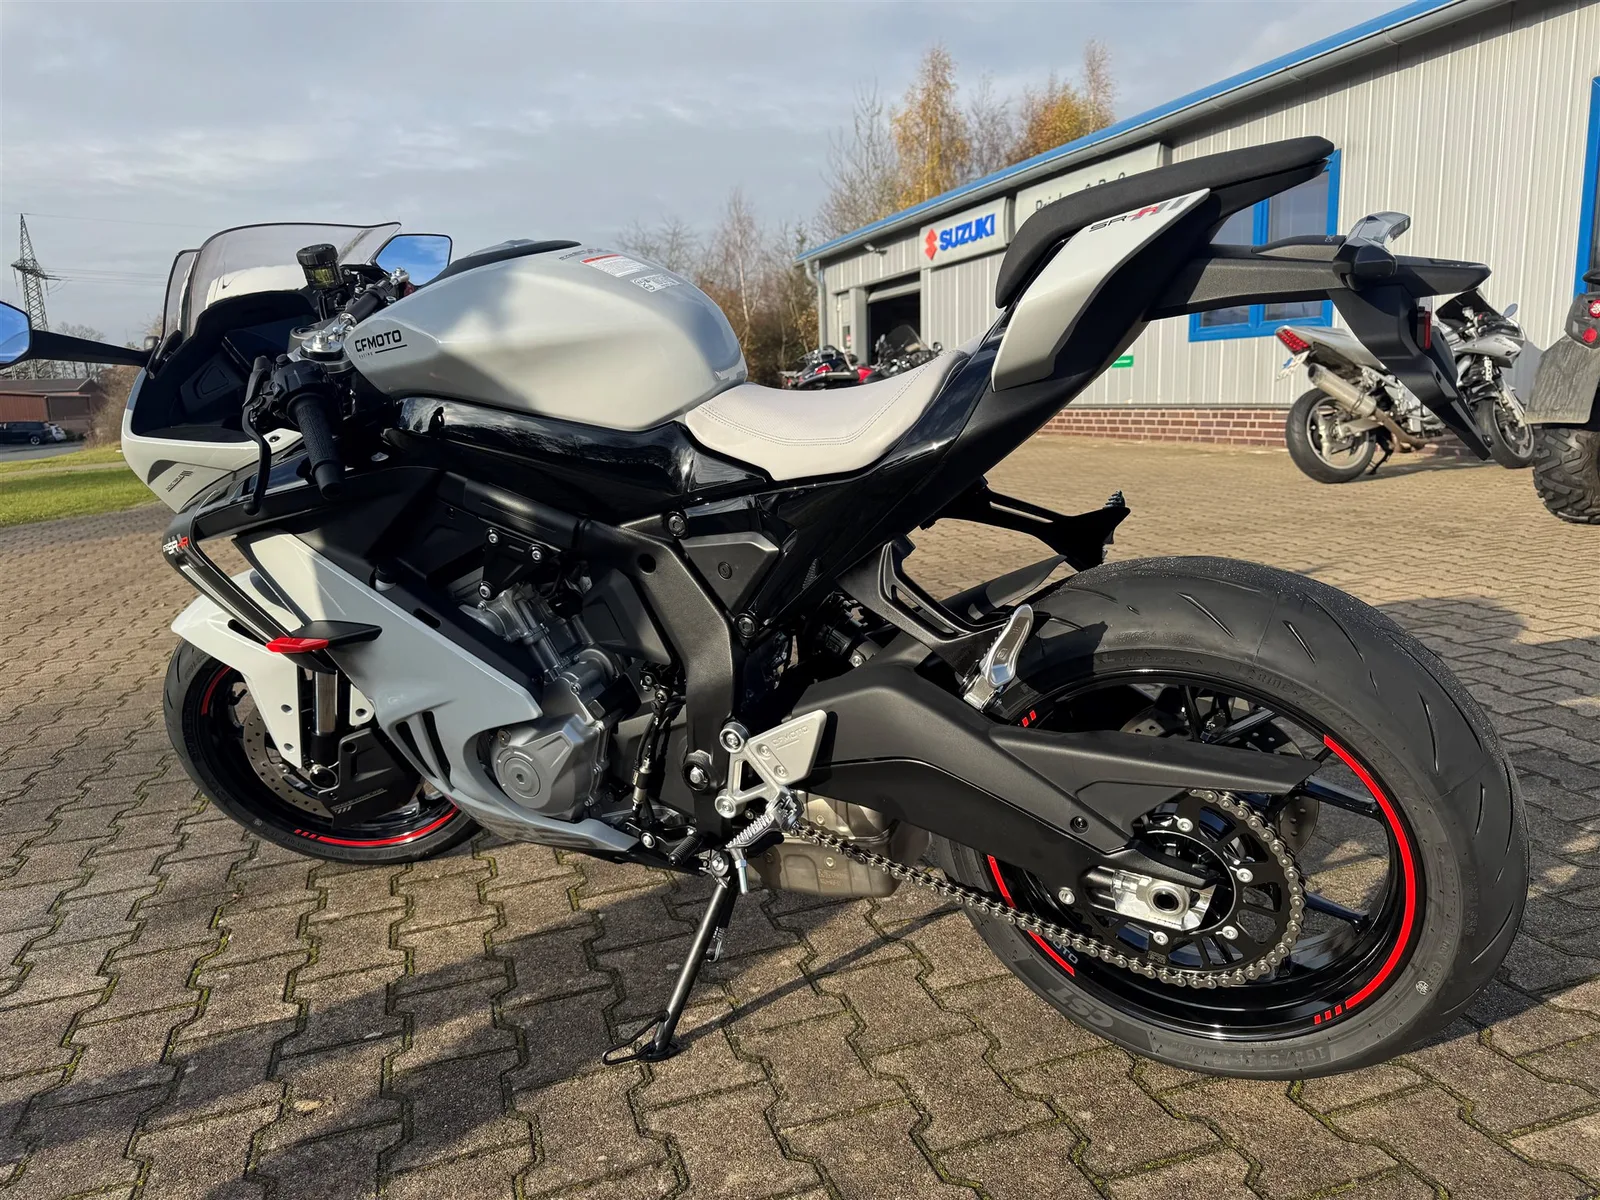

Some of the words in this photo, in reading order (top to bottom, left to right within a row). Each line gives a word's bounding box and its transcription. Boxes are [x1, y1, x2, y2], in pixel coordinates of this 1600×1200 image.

[939, 213, 996, 251] SUZUKI
[355, 329, 402, 353] CFMOTO
[1052, 939, 1079, 965] OTO
[1046, 987, 1114, 1028] CST
